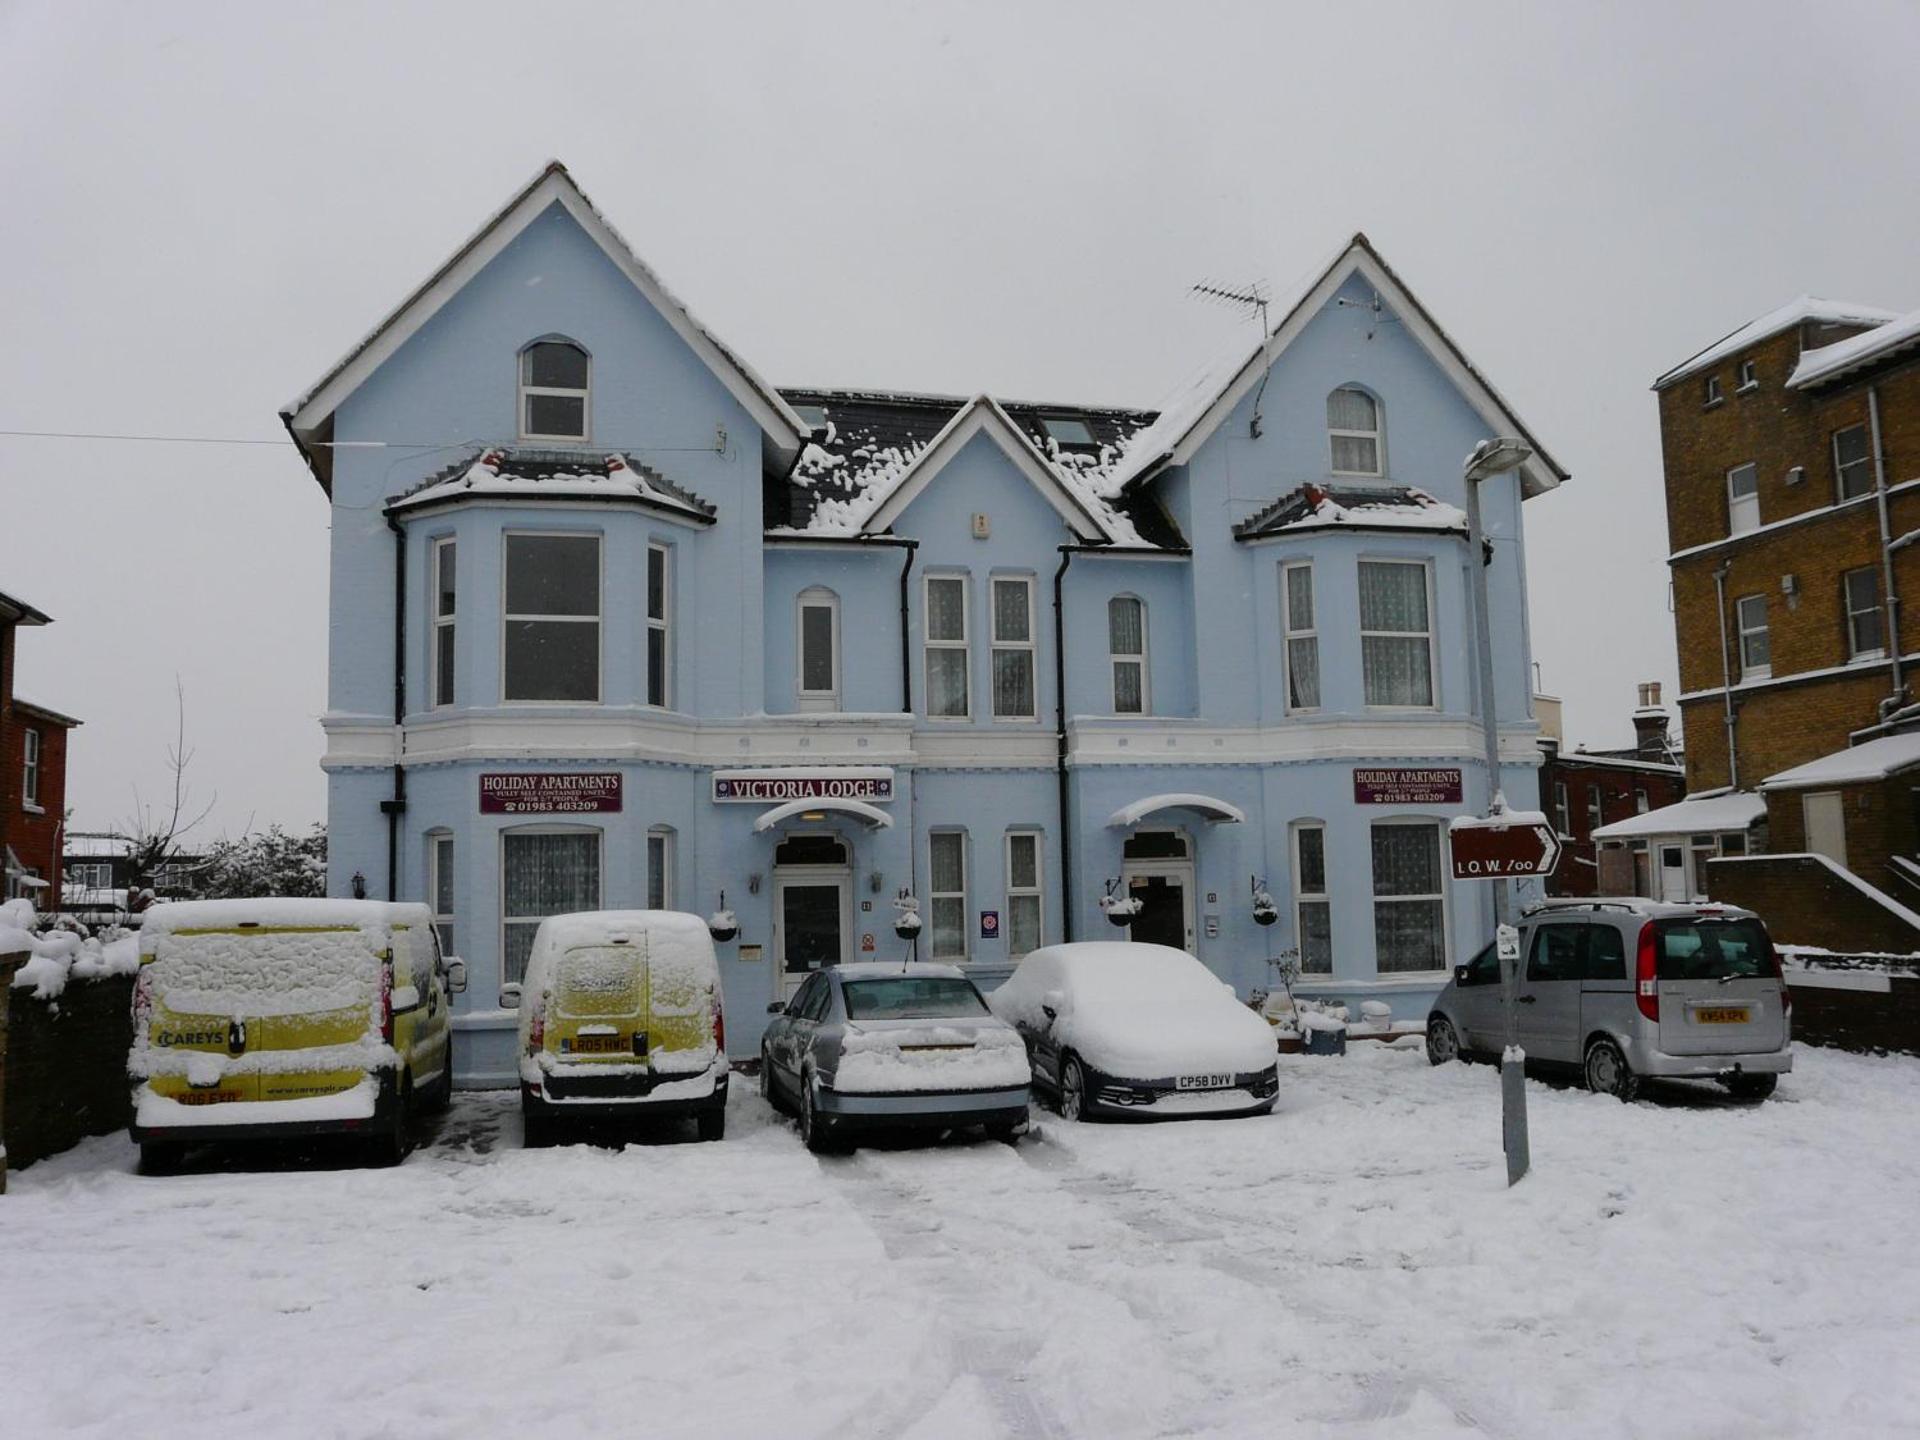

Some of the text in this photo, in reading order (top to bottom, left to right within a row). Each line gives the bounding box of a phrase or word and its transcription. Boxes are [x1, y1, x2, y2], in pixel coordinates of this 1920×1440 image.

[484, 775, 618, 790] HOLIDAY APARTMENTS
[1357, 771, 1459, 783] HOLIDAY APARTMENTS
[733, 780, 875, 798] VICTORIA LODGE
[518, 801, 598, 811] 01983 403209
[158, 1030, 224, 1047] CAREYS
[1180, 1076, 1209, 1087] CP58
